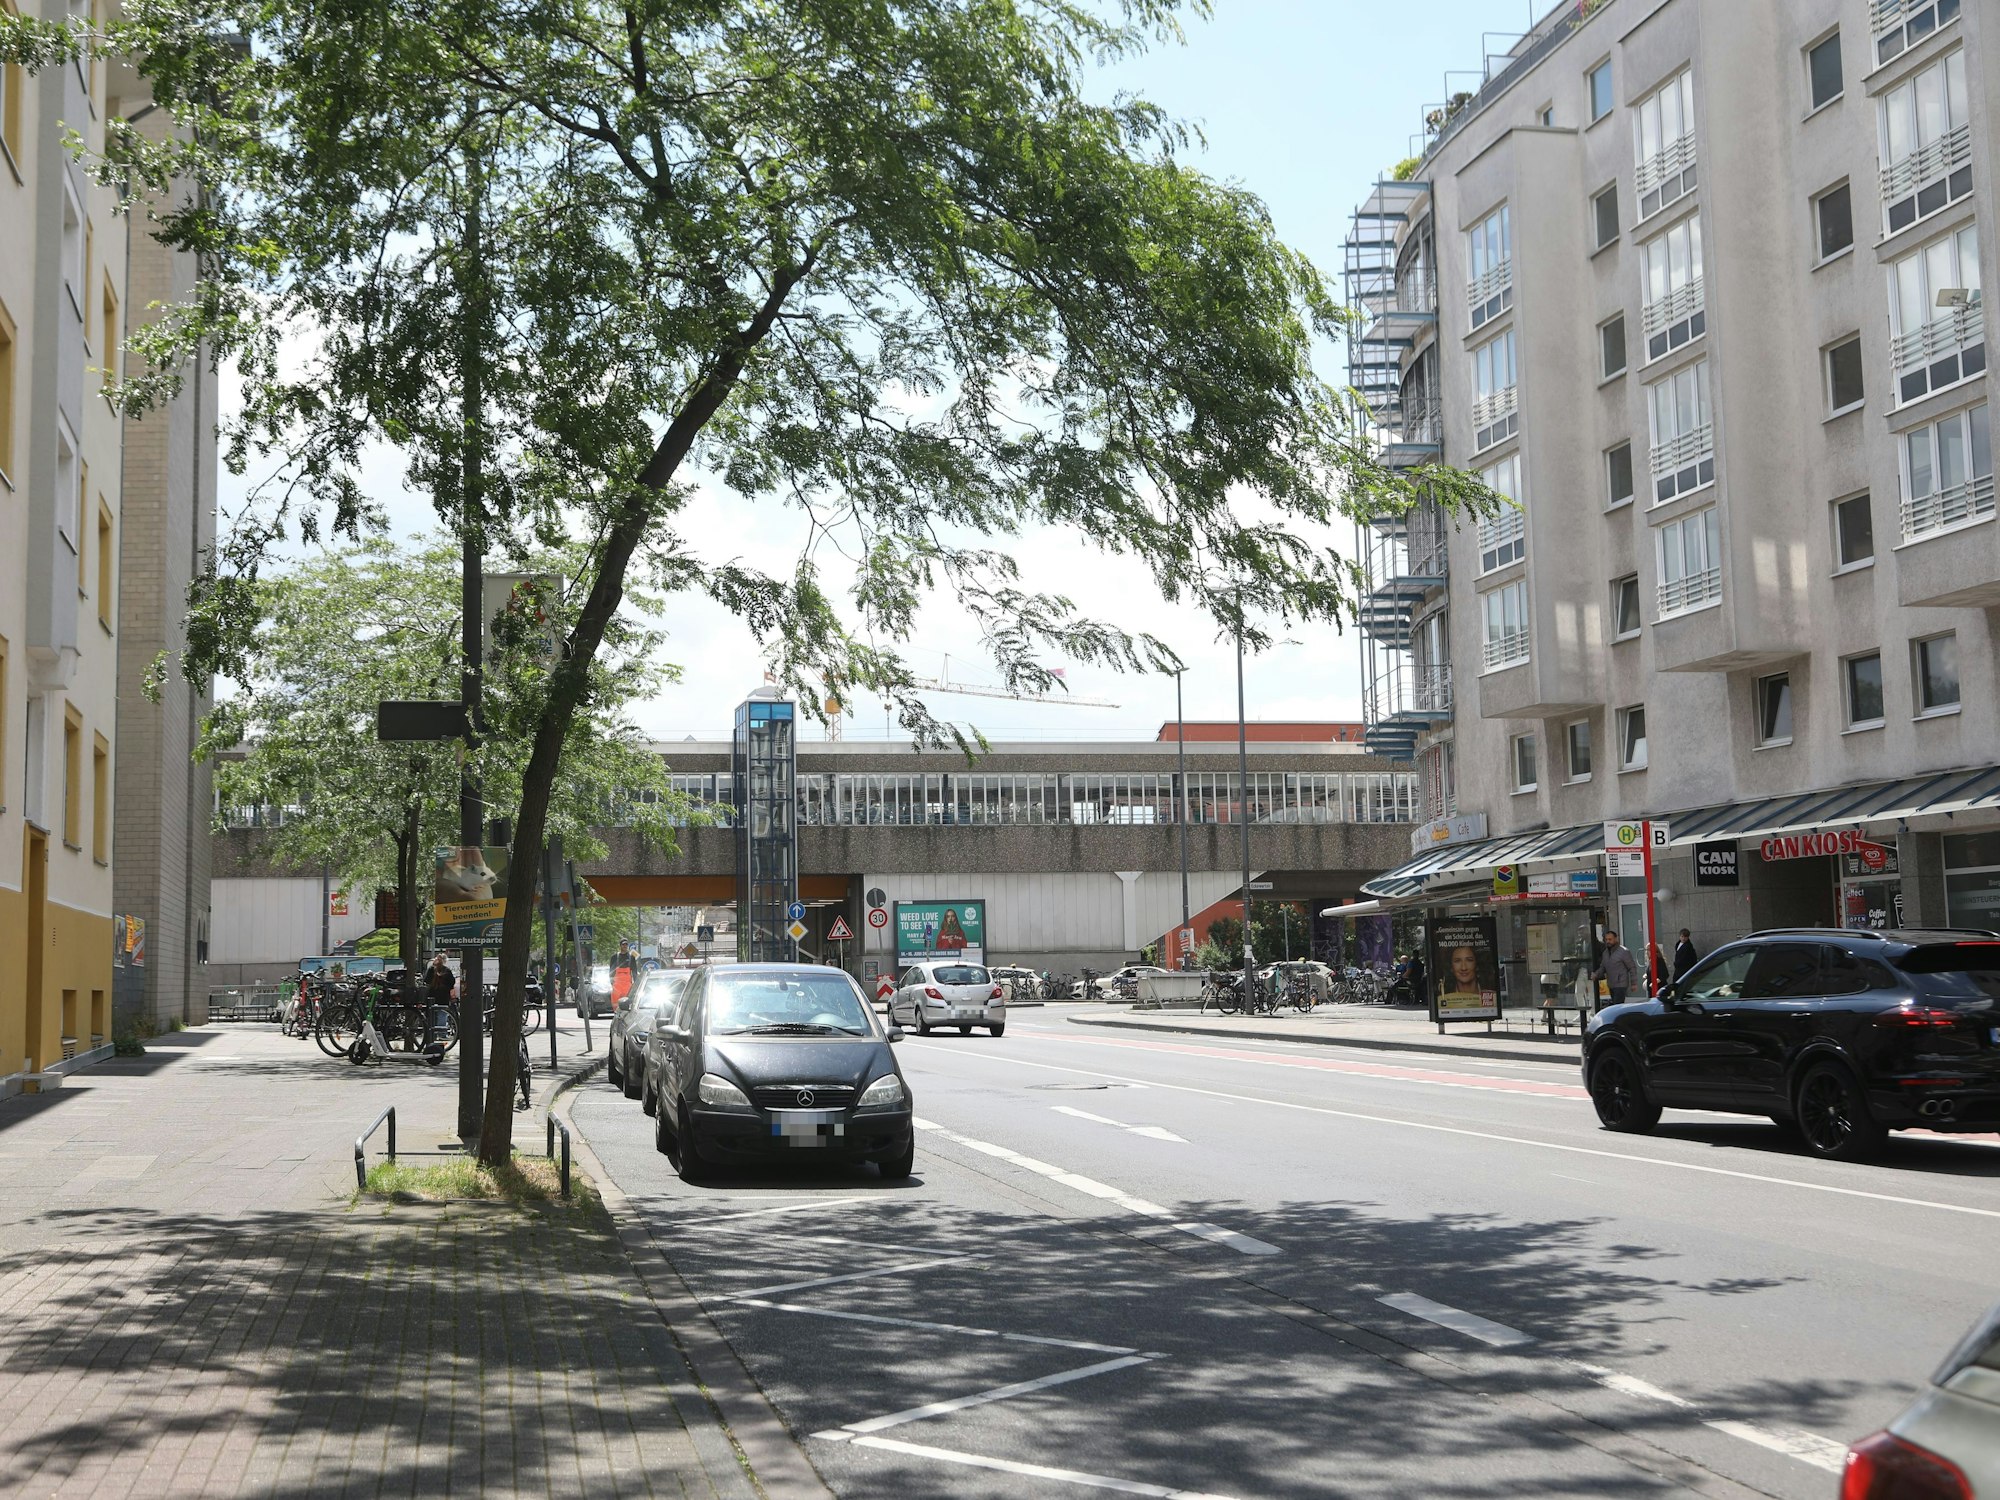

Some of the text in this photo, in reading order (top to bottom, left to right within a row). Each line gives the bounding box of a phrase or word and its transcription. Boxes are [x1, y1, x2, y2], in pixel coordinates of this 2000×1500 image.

[1457, 821, 1470, 835] Café
[1622, 829, 1631, 841] H
[1654, 830, 1666, 845] B
[1760, 828, 1865, 862] CAN KIOSK
[1698, 852, 1735, 864] CAN
[1699, 866, 1736, 875] KIOSK
[443, 901, 499, 913] Tierversuche
[452, 911, 492, 920] beenden!
[872, 913, 884, 924] 30
[900, 912, 938, 921] WEED LOVE
[1868, 909, 1887, 919] Coffee
[901, 921, 908, 930] TO
[910, 921, 922, 930] SEE
[1877, 920, 1885, 928] go
